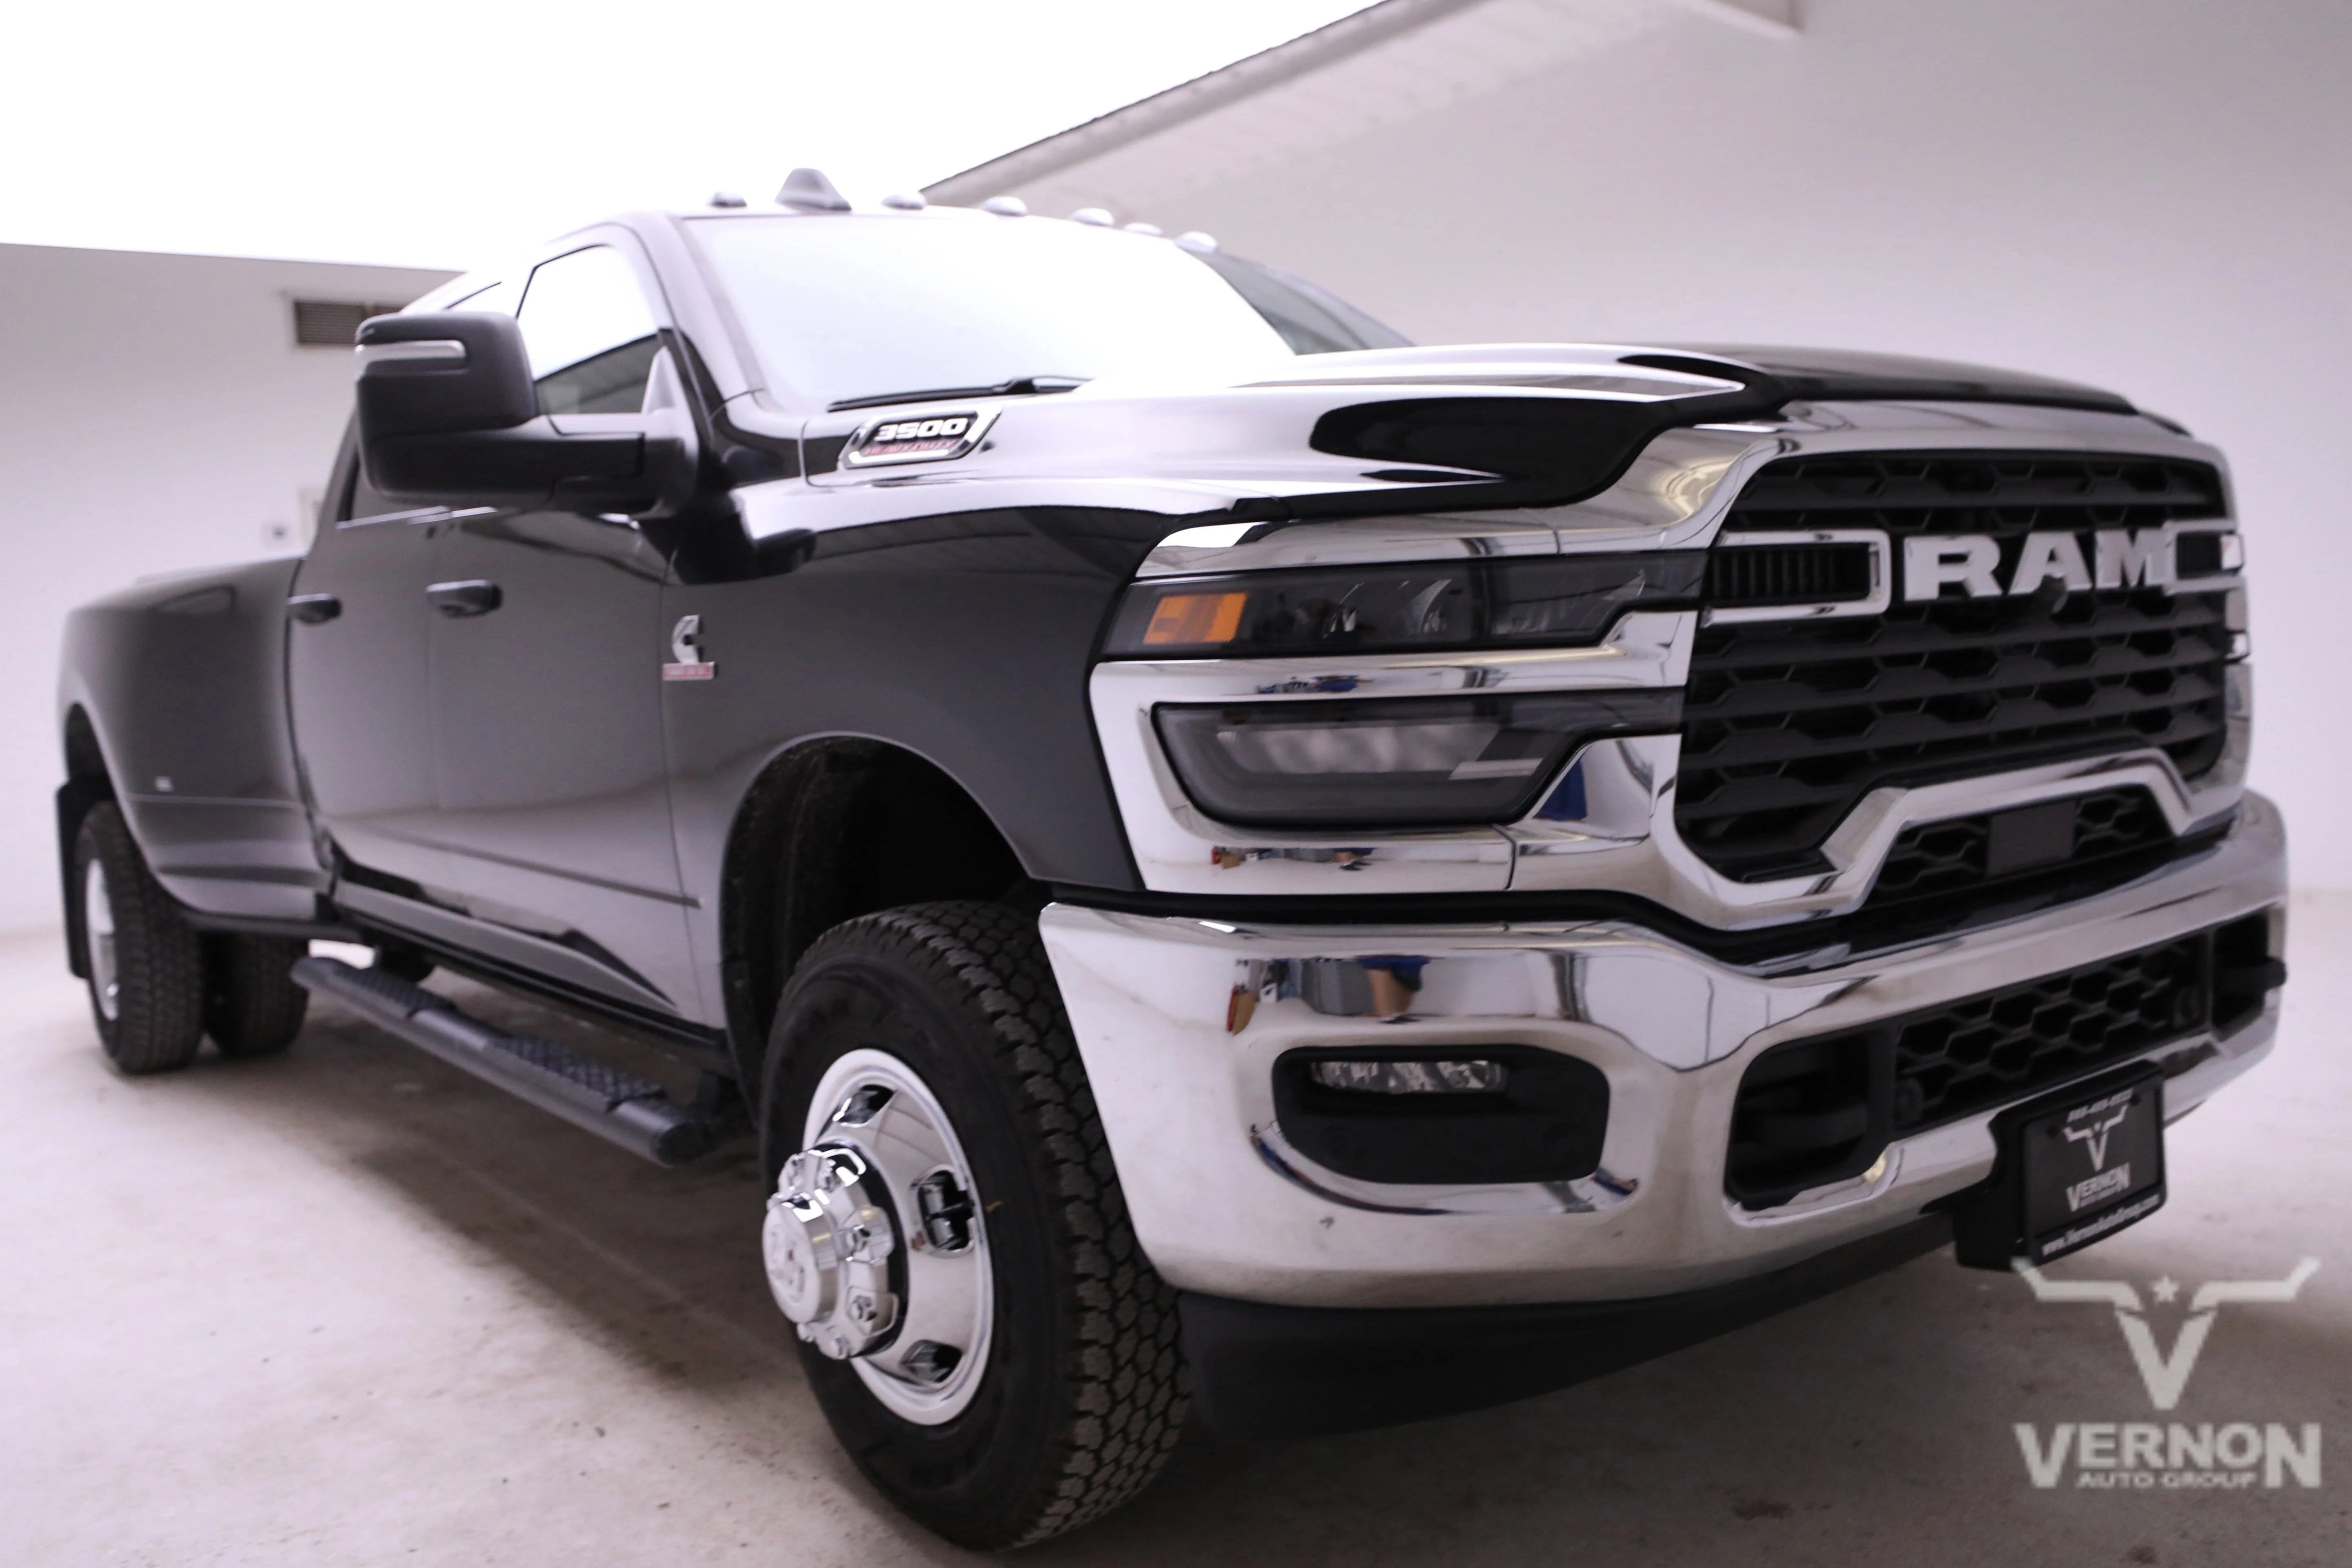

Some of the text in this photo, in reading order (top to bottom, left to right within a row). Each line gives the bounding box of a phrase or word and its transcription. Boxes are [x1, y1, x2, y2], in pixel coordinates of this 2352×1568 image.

[873, 417, 969, 442] 3500
[1903, 528, 2169, 602] RAM
[2066, 1162, 2130, 1212] VERNON
